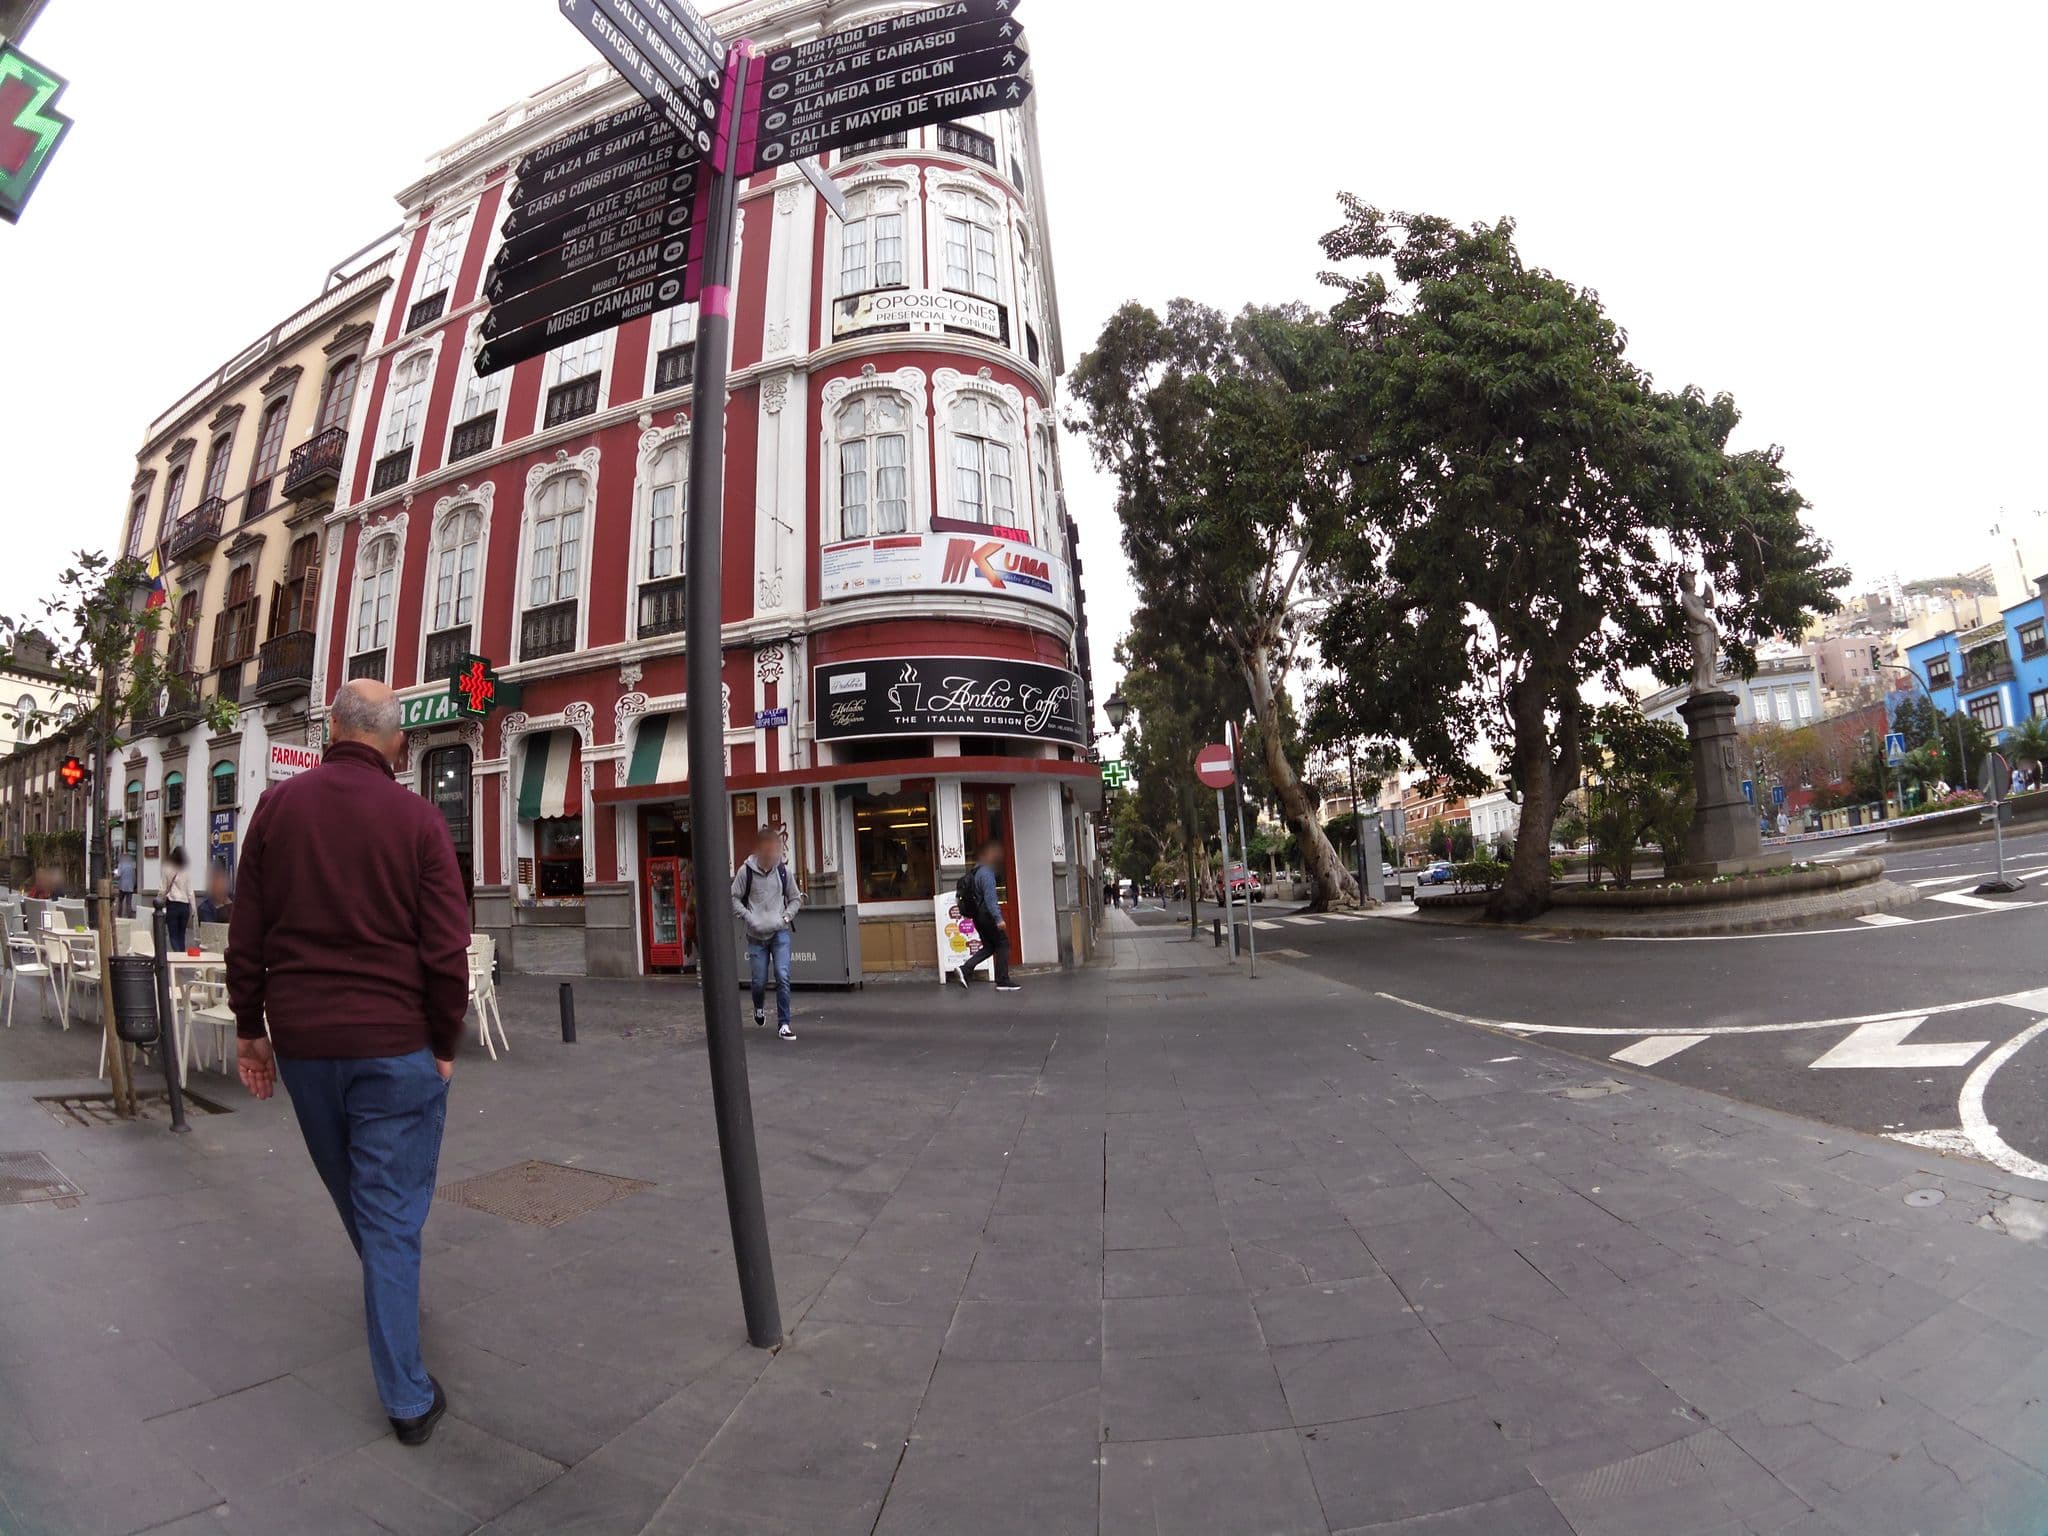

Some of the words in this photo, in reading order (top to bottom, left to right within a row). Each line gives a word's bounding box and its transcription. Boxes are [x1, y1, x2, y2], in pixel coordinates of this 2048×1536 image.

[657, 3, 670, 24] DE
[671, 17, 707, 69] VEGUETA
[797, 31, 863, 58] HURTADO
[868, 22, 887, 36] DE
[893, 2, 968, 30] MENDOZA
[613, 0, 646, 35] CALLE
[646, 28, 701, 98] MENDIZÁBAL
[795, 59, 846, 86] PLAZA
[852, 51, 871, 68] DE
[876, 31, 956, 61] CAIRASCO
[797, 52, 825, 67] PLAZA
[835, 41, 867, 55] SQUARE
[591, 10, 639, 69] ESTACIÓN
[640, 61, 654, 85] DE
[654, 77, 697, 130] GUAGUAS
[793, 85, 870, 115] ALAMEDA
[875, 75, 896, 92] DE
[901, 60, 954, 84] COLÓN
[794, 80, 825, 95] SQUARE
[683, 86, 700, 108] STREET
[790, 118, 840, 146] CALLE
[846, 103, 902, 131] MAYOR
[907, 96, 929, 115] DE
[935, 83, 998, 109] TRIANA
[535, 128, 591, 162] CATEDRAL
[594, 120, 609, 134] DE
[613, 103, 652, 126] SANTA
[665, 106, 676, 122] BUS
[676, 117, 694, 142] STATION
[792, 110, 824, 126] SQUARE
[542, 159, 582, 185] PLAZA
[585, 148, 601, 163] DE
[605, 133, 645, 157] SANTA
[650, 122, 671, 138] AN
[649, 131, 675, 146] SQUARE
[789, 142, 819, 158] STREET
[527, 190, 566, 217] CASAS
[569, 145, 674, 198] CONSISTORIALES
[633, 169, 652, 182] TOWN
[653, 161, 671, 174] HALL
[562, 223, 587, 240] MUSEO
[588, 208, 628, 231] DIOCESANO
[636, 193, 666, 212] MUSEUM
[587, 194, 621, 221] ARTE
[624, 177, 669, 205] SACRO
[561, 237, 595, 262] CASA
[600, 230, 616, 246] DE
[620, 210, 663, 238] COLÓN
[567, 253, 594, 270] MUSEUM
[601, 235, 637, 256] COLUMBUS
[638, 227, 661, 241] HOUSE
[617, 244, 660, 272] CAAM
[592, 277, 618, 294] MUSEO
[627, 262, 657, 281] MUSEUM
[546, 308, 590, 336] MUSEO
[594, 281, 655, 317] CANARIO
[622, 301, 652, 320] MUSEUM
[876, 295, 997, 322] OPOSICIONES
[876, 310, 946, 321] PRESENCIAL
[950, 314, 957, 323] Y
[960, 317, 998, 333] ONLINE
[928, 676, 1014, 711] Antico
[927, 715, 974, 723] ITALIAN
[983, 716, 1022, 725] DESIGN
[271, 746, 320, 768] FARMACIA
[215, 813, 229, 824] ATM
